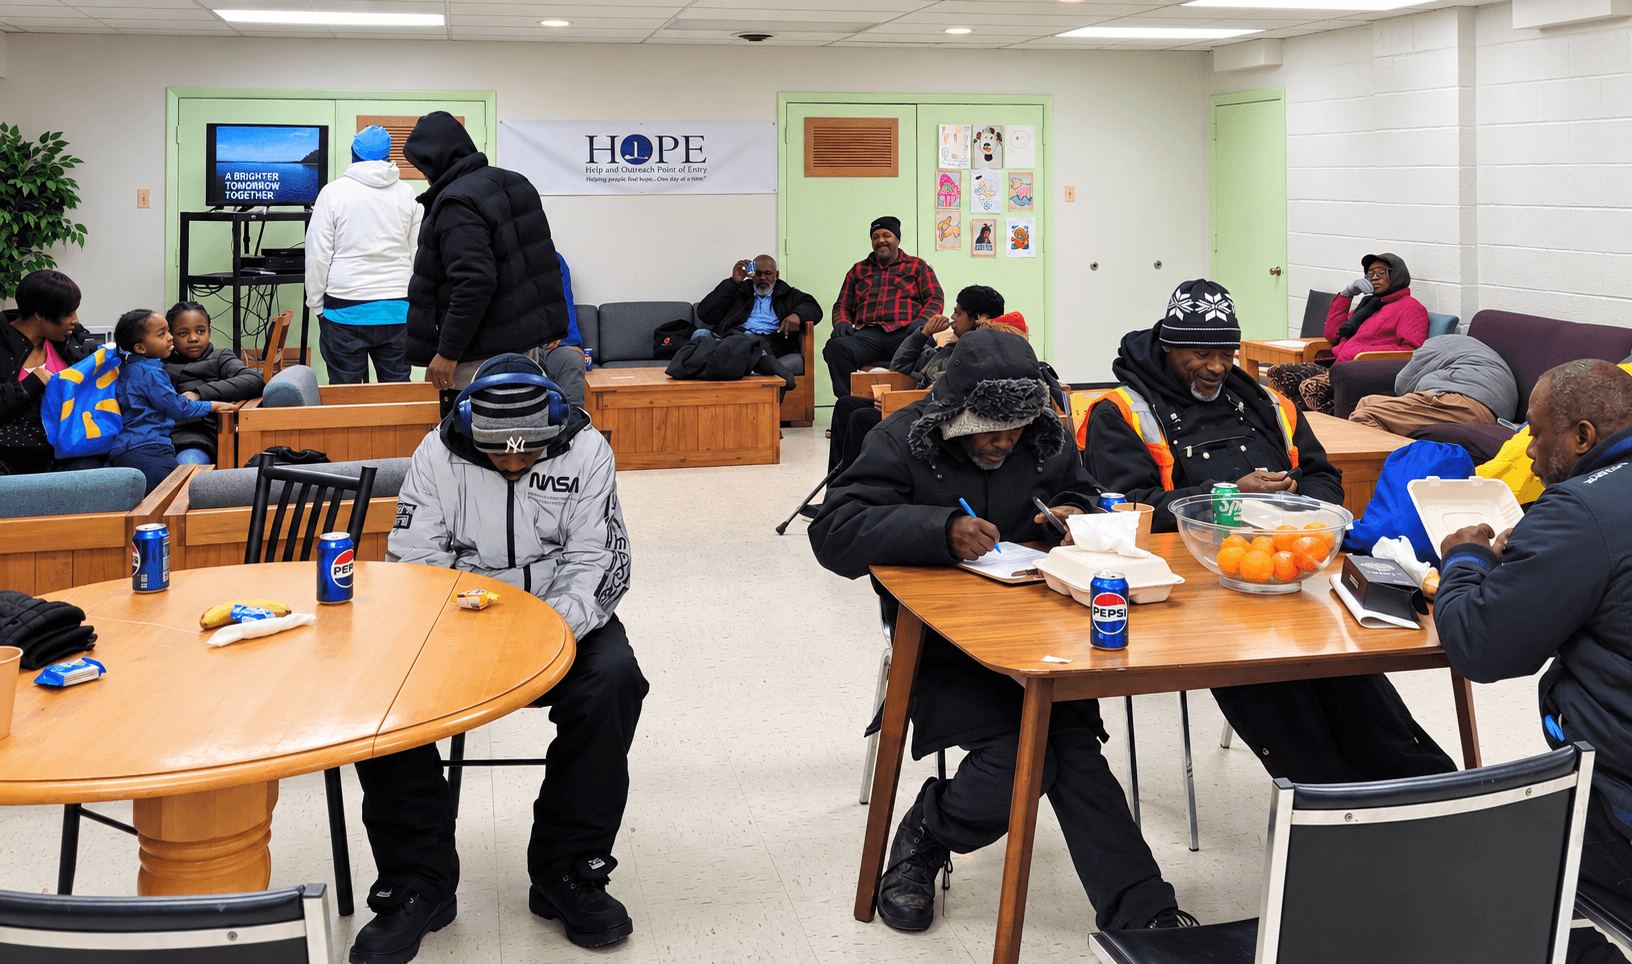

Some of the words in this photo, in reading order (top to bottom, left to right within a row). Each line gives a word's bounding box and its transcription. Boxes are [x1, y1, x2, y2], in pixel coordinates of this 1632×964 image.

[585, 134, 707, 165] HOPE
[585, 166, 604, 175] Help
[605, 166, 619, 174] and
[620, 166, 655, 174] Outreach
[657, 166, 676, 174] Point
[678, 166, 686, 174] of
[687, 166, 708, 175] Entry
[225, 172, 231, 180] A
[234, 172, 279, 180] BRIGHTER
[669, 176, 679, 184] day
[225, 181, 280, 190] TOMORROW
[225, 191, 274, 200] TOGETHER
[505, 436, 526, 454] NY
[529, 472, 579, 493] NASA
[1093, 605, 1127, 618] PEPSI
